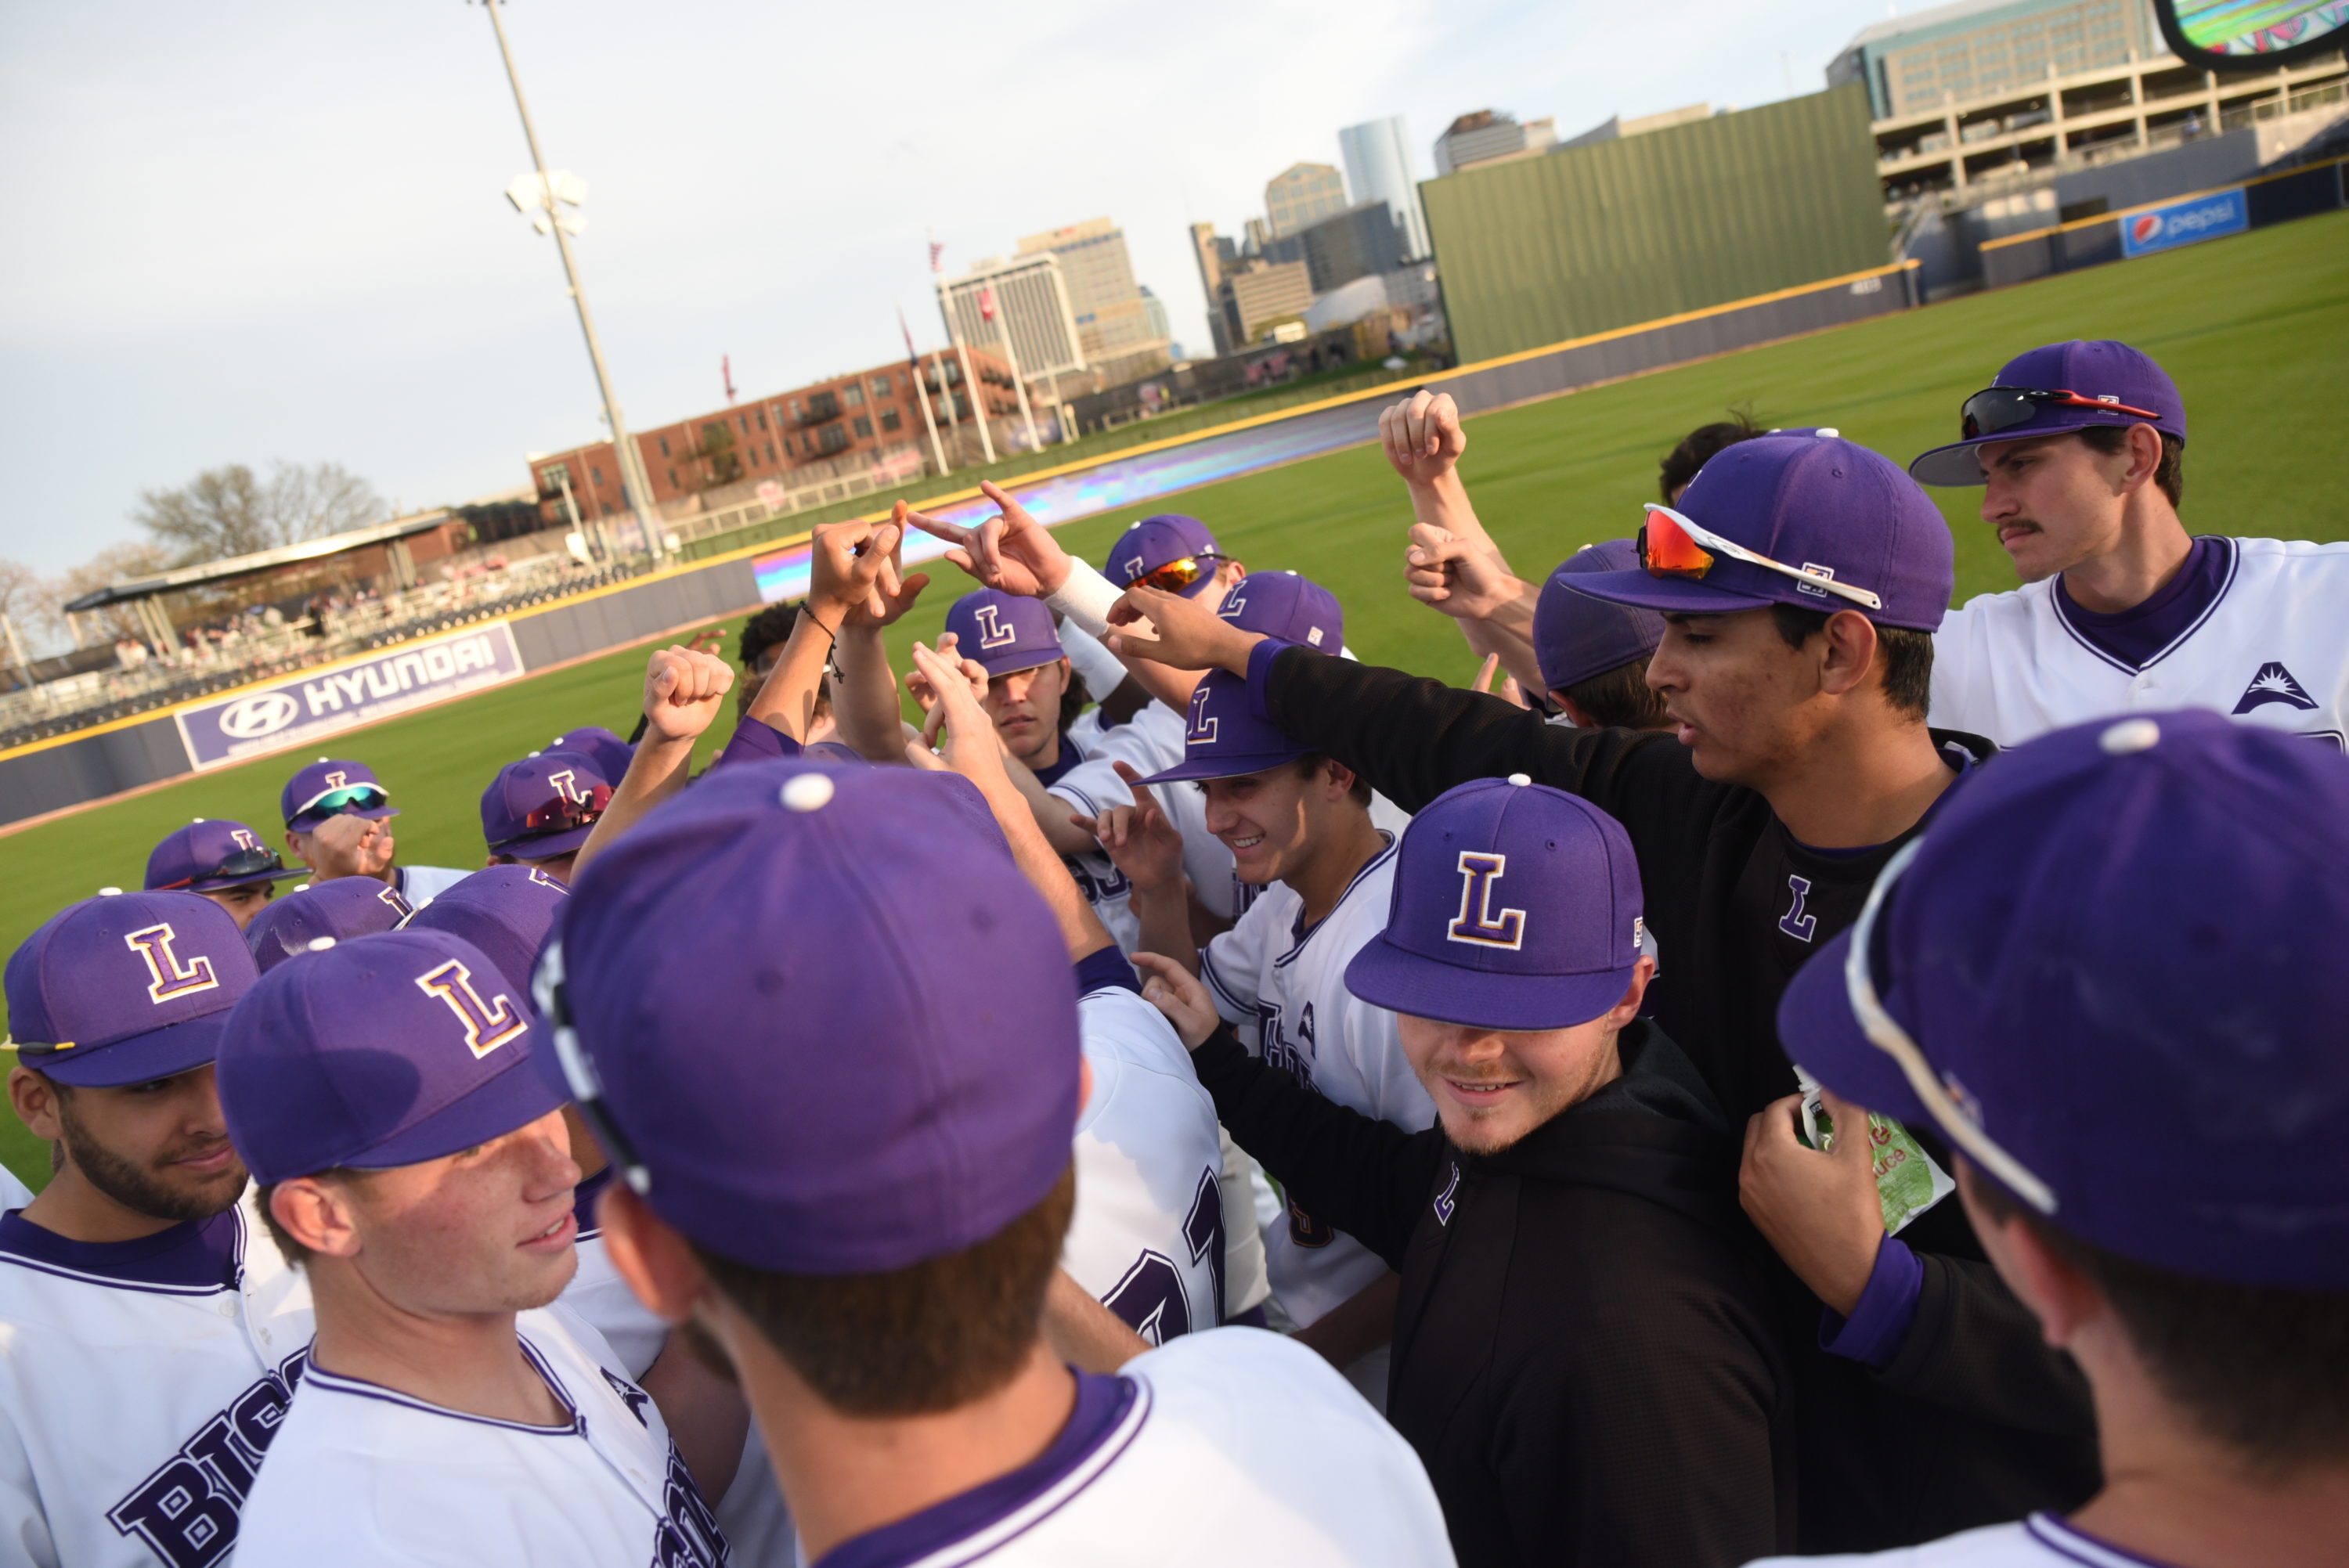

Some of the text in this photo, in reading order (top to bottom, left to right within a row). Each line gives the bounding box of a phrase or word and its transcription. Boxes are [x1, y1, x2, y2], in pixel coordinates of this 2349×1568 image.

[2167, 198, 2235, 238] pepsi
[974, 604, 1016, 649] L
[303, 634, 496, 716] HYUNDAI
[1186, 687, 1218, 745] L
[1447, 850, 1526, 951] L
[1779, 874, 1817, 943] L
[124, 922, 219, 1005] L
[414, 957, 529, 1060] L
[1434, 1162, 1460, 1227] L
